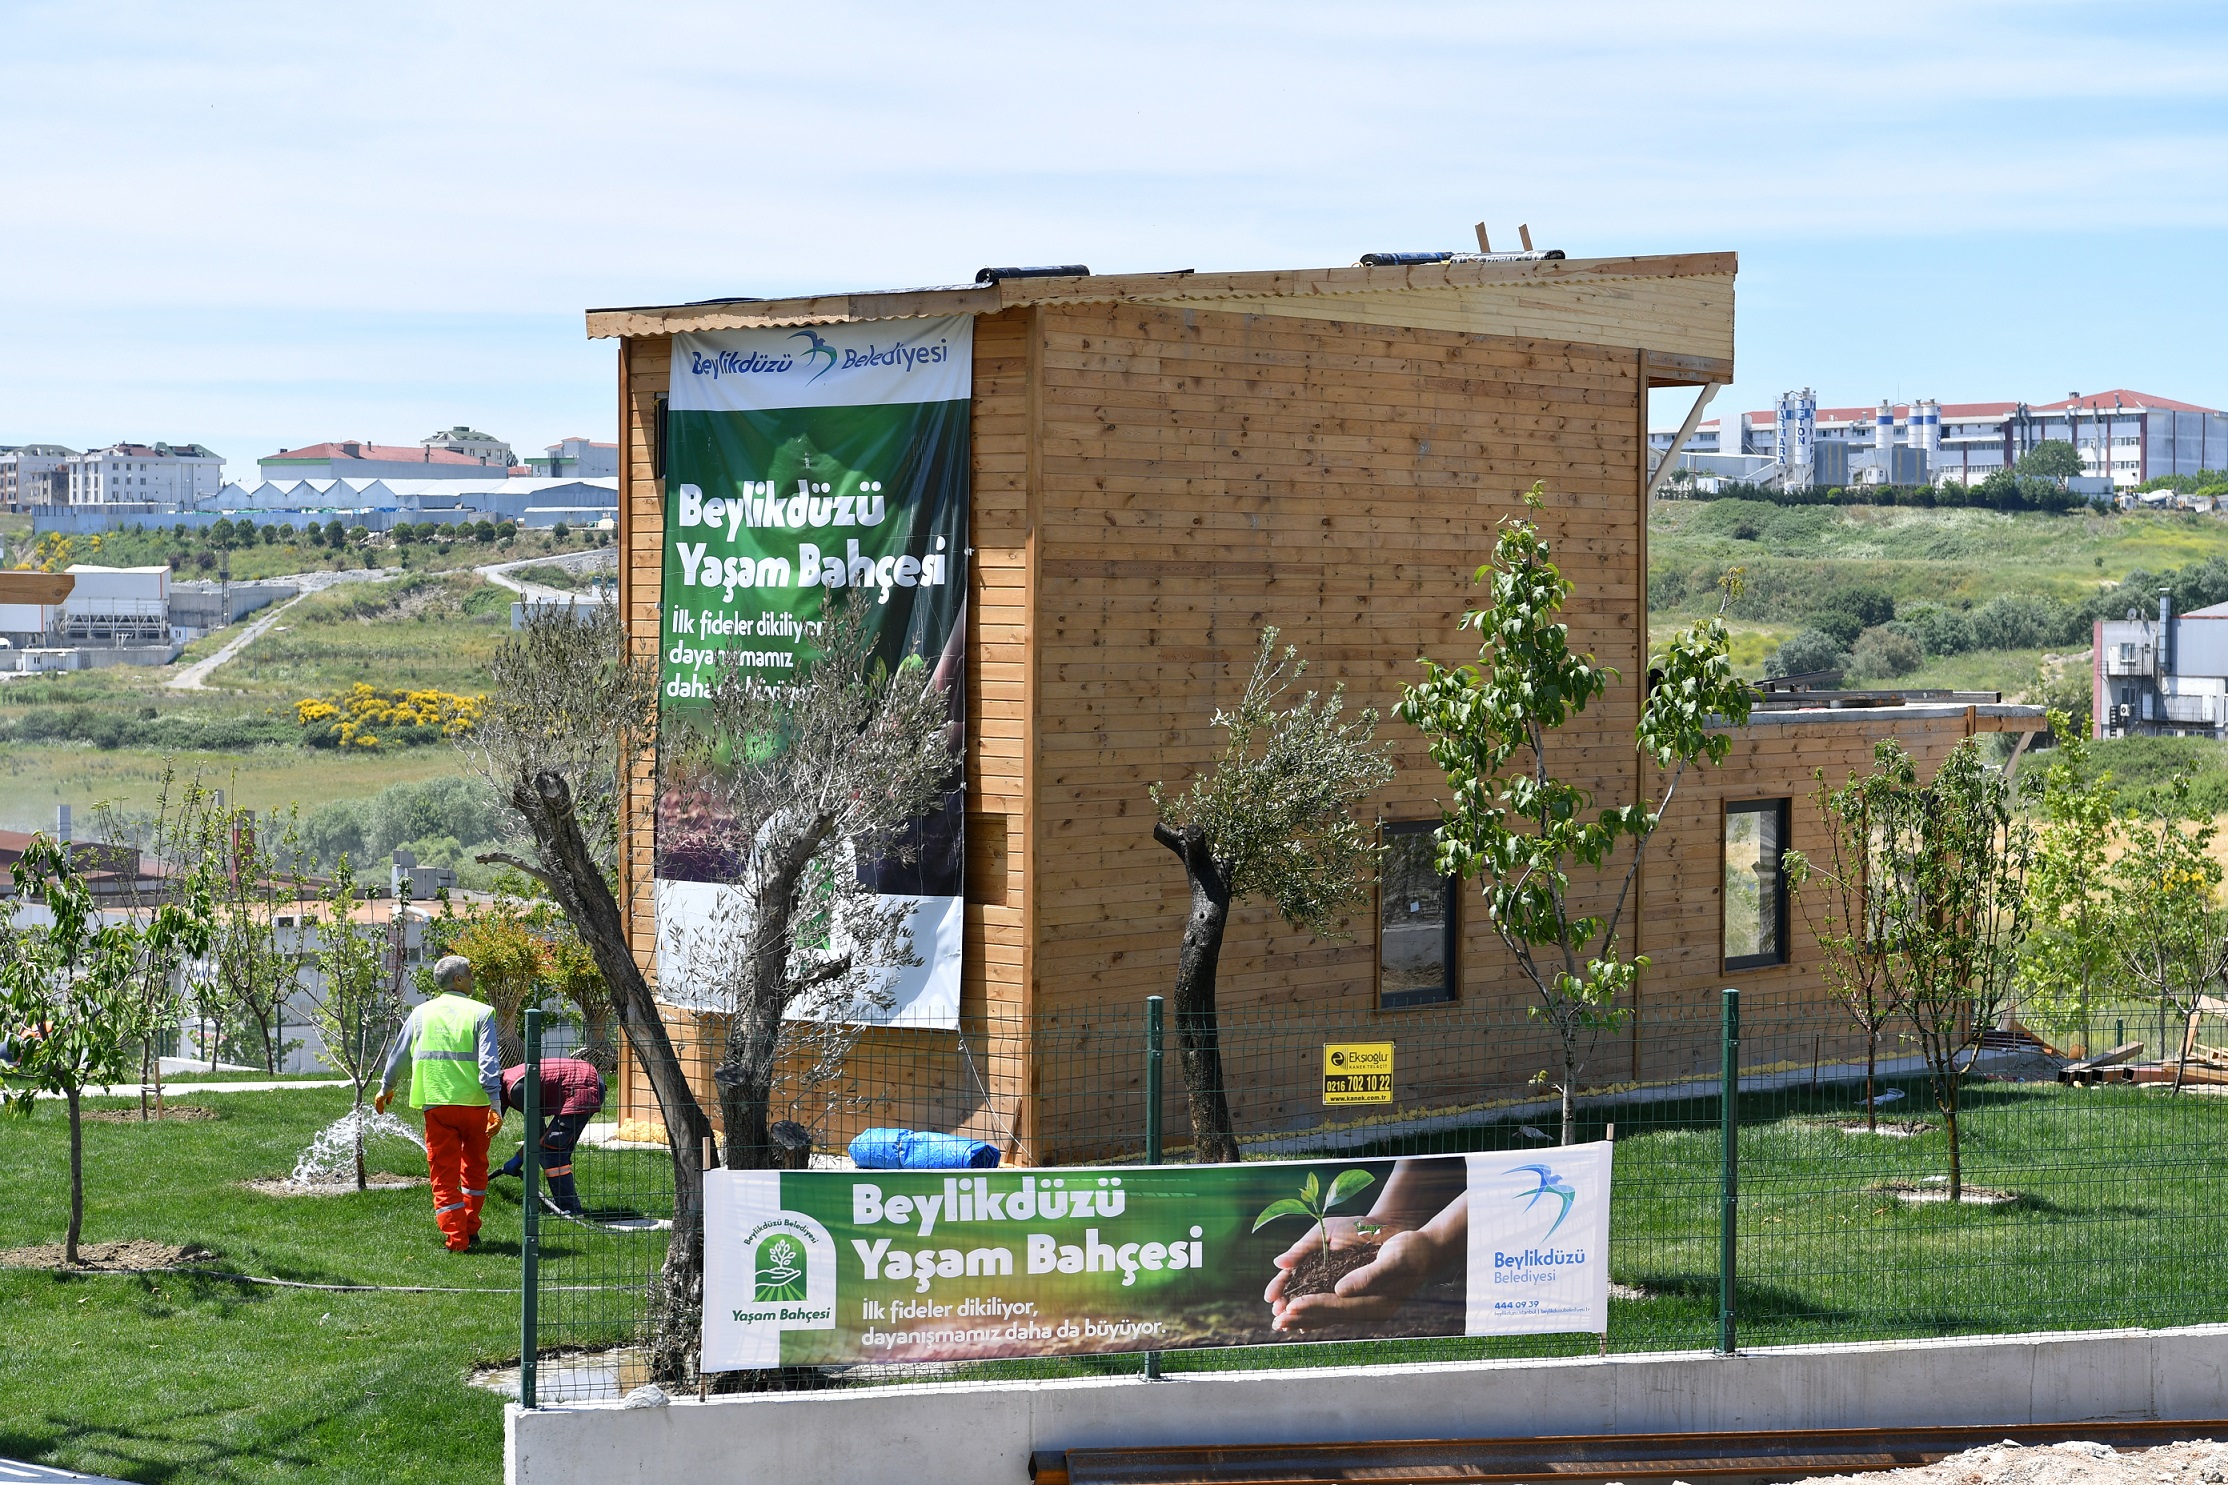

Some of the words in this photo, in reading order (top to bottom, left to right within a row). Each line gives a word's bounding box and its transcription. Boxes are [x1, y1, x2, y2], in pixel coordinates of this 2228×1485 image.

[691, 351, 793, 380] Beylikdüzü
[841, 338, 948, 372] Belediyesi
[1778, 401, 1786, 465] MARMARA
[678, 479, 886, 542] Beylikdüzü
[676, 542, 791, 603] Yaşam
[798, 536, 946, 604] Bahçesi
[672, 605, 695, 634] İlk
[700, 609, 754, 641] fideler
[666, 673, 713, 699] daha
[1327, 1081, 1345, 1092] 0216
[1347, 1075, 1364, 1091] 702
[1367, 1075, 1377, 1091] 10
[1379, 1074, 1390, 1091] 22
[851, 1176, 1126, 1236] Beylikdüzü
[743, 1219, 782, 1245] Beylikdüzü
[784, 1219, 819, 1244] Belediyesi
[851, 1238, 1013, 1294] Yaşam
[1027, 1225, 1204, 1287] Bahçesi
[1494, 1248, 1586, 1270] Beylikdüzü
[1494, 1269, 1556, 1286] Belediyesi
[732, 1309, 776, 1325] Yaşam
[780, 1307, 831, 1323] Bahçesi
[862, 1297, 886, 1321] İlk
[890, 1300, 953, 1324] fideler
[957, 1296, 1039, 1322] dikiliyor,
[1494, 1301, 1513, 1309] 444
[1515, 1301, 1527, 1309] 09
[1528, 1300, 1540, 1308] 39
[861, 1326, 1001, 1350] dayanışmamız
[1005, 1321, 1052, 1342] daha
[1057, 1319, 1080, 1338] da
[1084, 1318, 1167, 1342] büyüyor.
